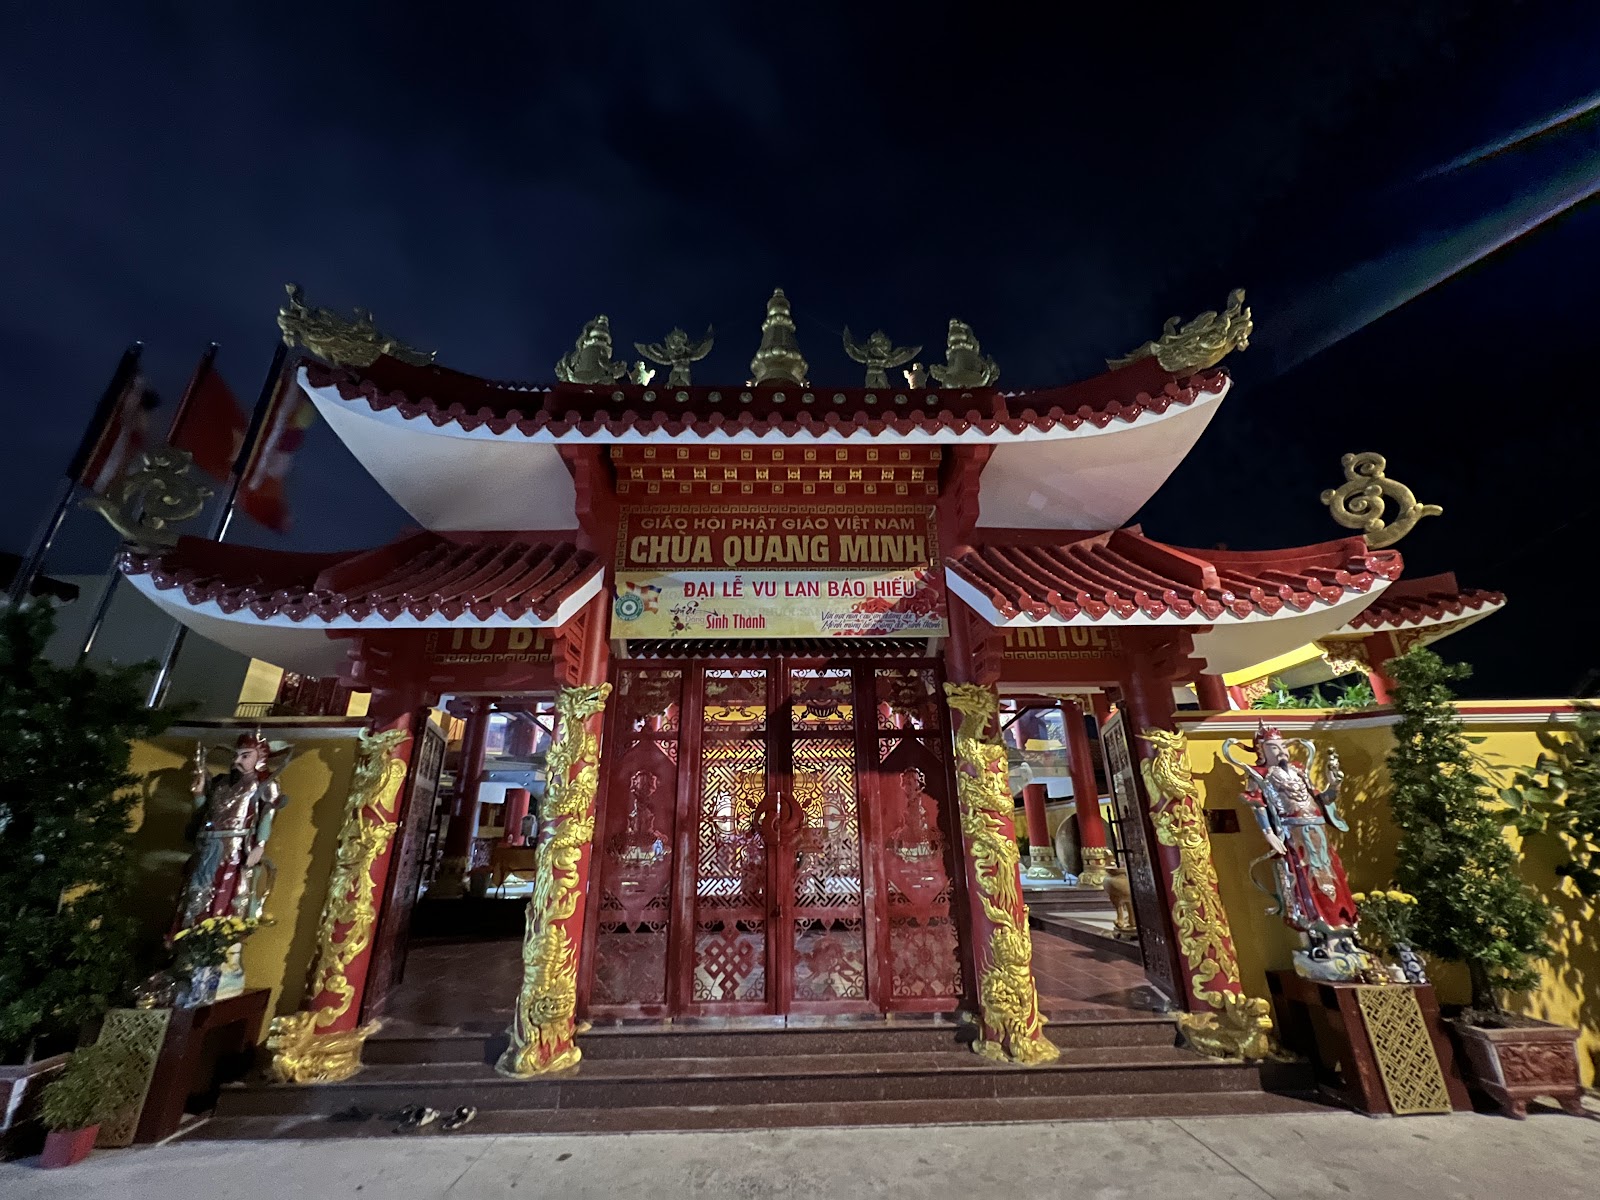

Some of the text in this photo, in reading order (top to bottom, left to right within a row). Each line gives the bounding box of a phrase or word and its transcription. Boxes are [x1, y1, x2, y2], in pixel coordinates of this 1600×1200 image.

[641, 515, 915, 533] GIÁO HỘI PHẬT GIÁO VIỆT NAM
[630, 530, 927, 567] CHÙA QUANG MINH
[684, 581, 715, 600] ĐẠI
[723, 575, 743, 597] LỄ
[752, 581, 776, 597] VU
[785, 581, 819, 597] LAN
[828, 577, 866, 597] BÁO
[874, 576, 915, 597] HIẾU
[706, 614, 729, 629] Sinh
